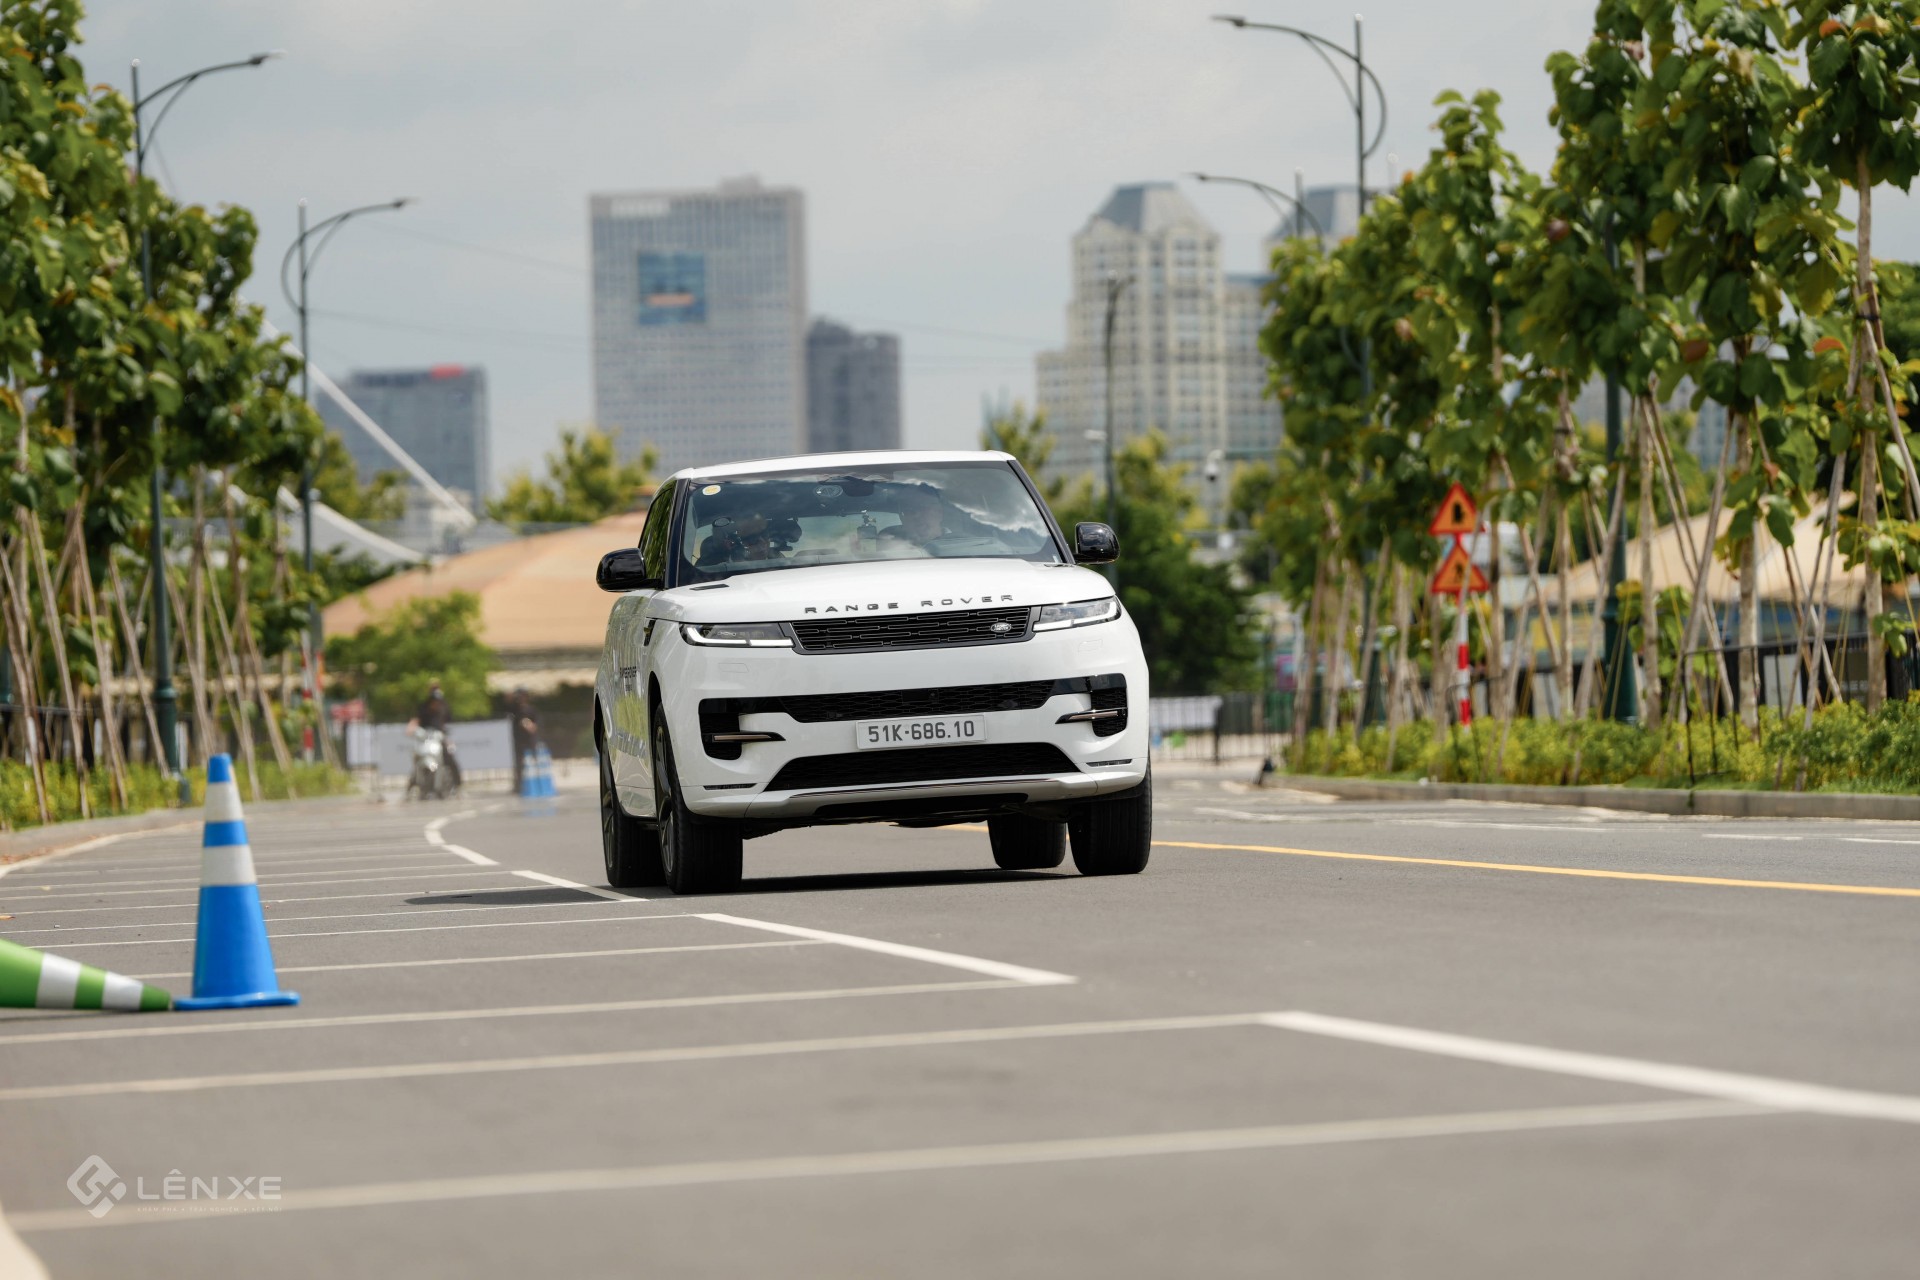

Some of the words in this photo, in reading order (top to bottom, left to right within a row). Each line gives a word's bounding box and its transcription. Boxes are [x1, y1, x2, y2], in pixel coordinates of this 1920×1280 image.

[804, 602, 899, 614] RANGE
[920, 594, 1014, 607] ROVER
[868, 720, 975, 743] 51K-686.10
